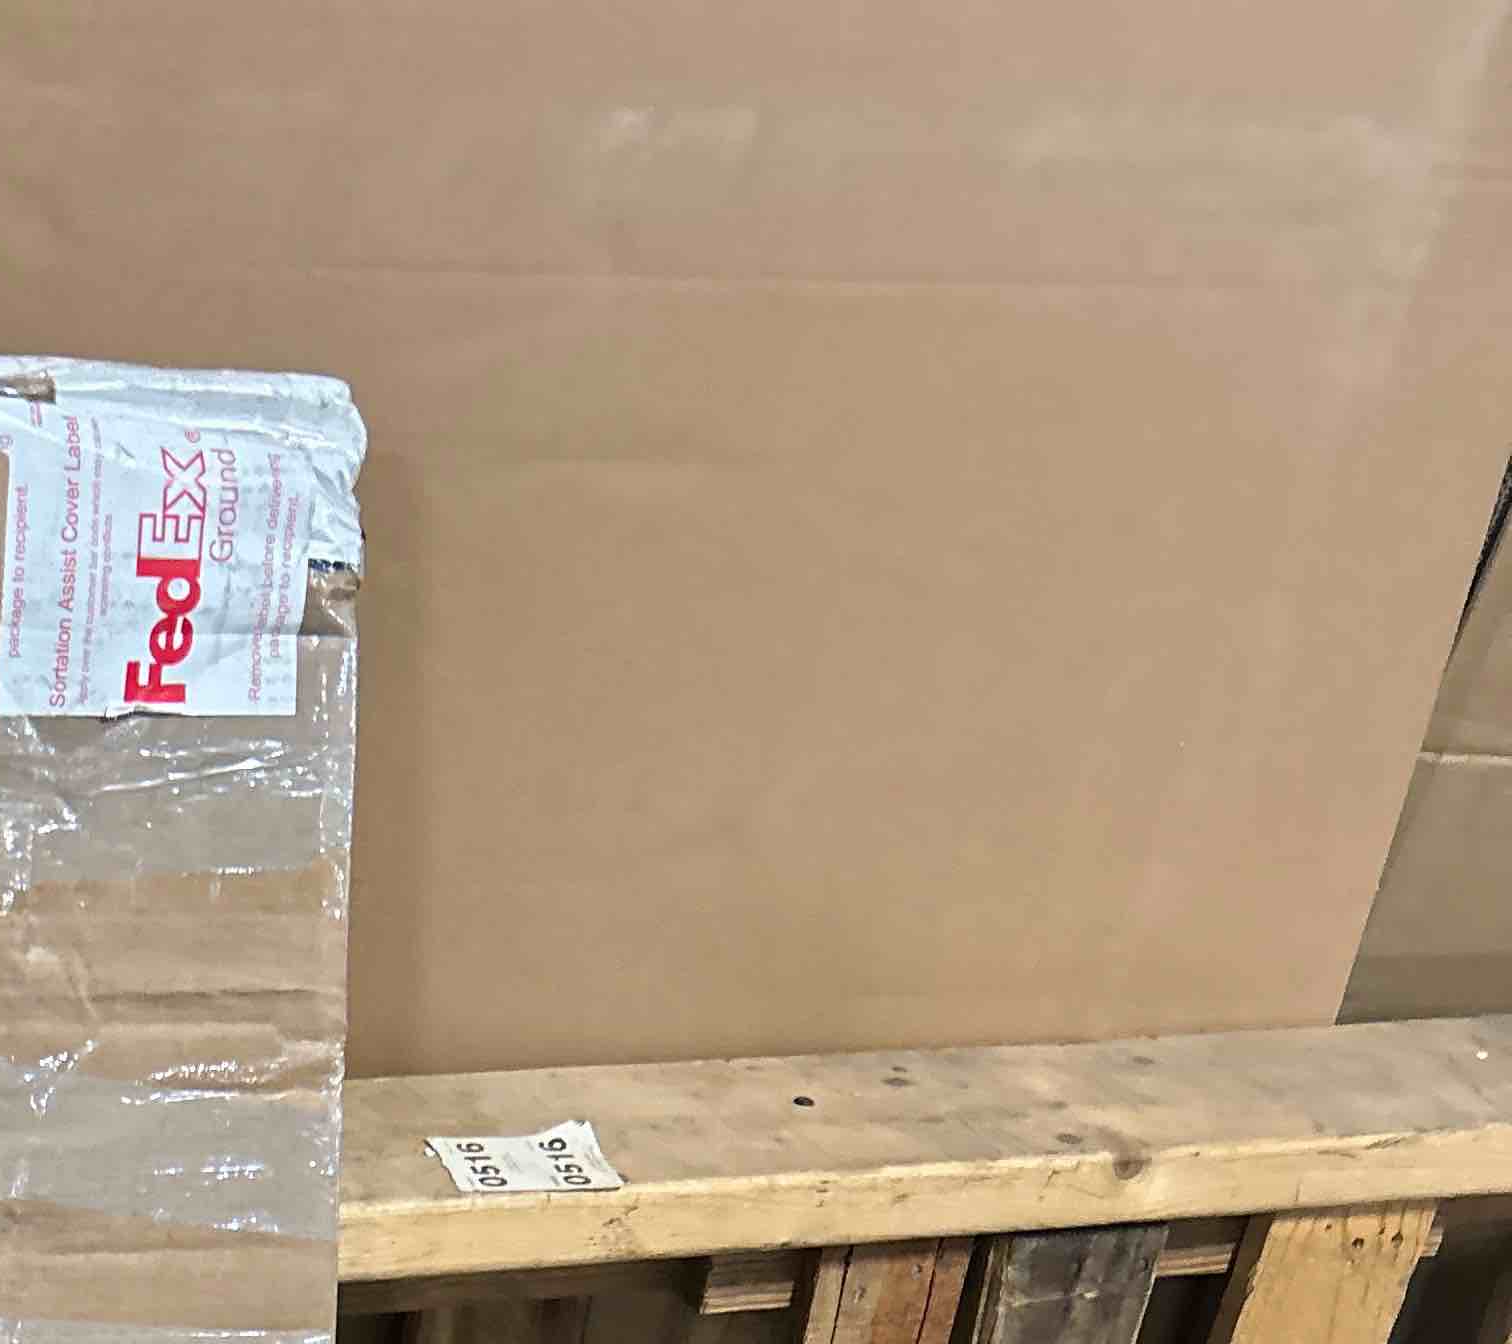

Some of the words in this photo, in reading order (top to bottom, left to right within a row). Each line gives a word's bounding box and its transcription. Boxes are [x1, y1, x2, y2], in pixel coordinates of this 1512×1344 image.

[63, 415, 81, 471] Label
[61, 477, 80, 543] Cover
[209, 448, 238, 562] Ground
[12, 566, 25, 583] to
[58, 549, 77, 613] Assist
[124, 446, 207, 703] FedEx
[8, 587, 25, 658] package
[248, 631, 263, 702] Remove
[262, 535, 276, 591] before
[49, 617, 73, 708] Sortation
[456, 1142, 508, 1187] 0516
[539, 1137, 592, 1186] 0516
